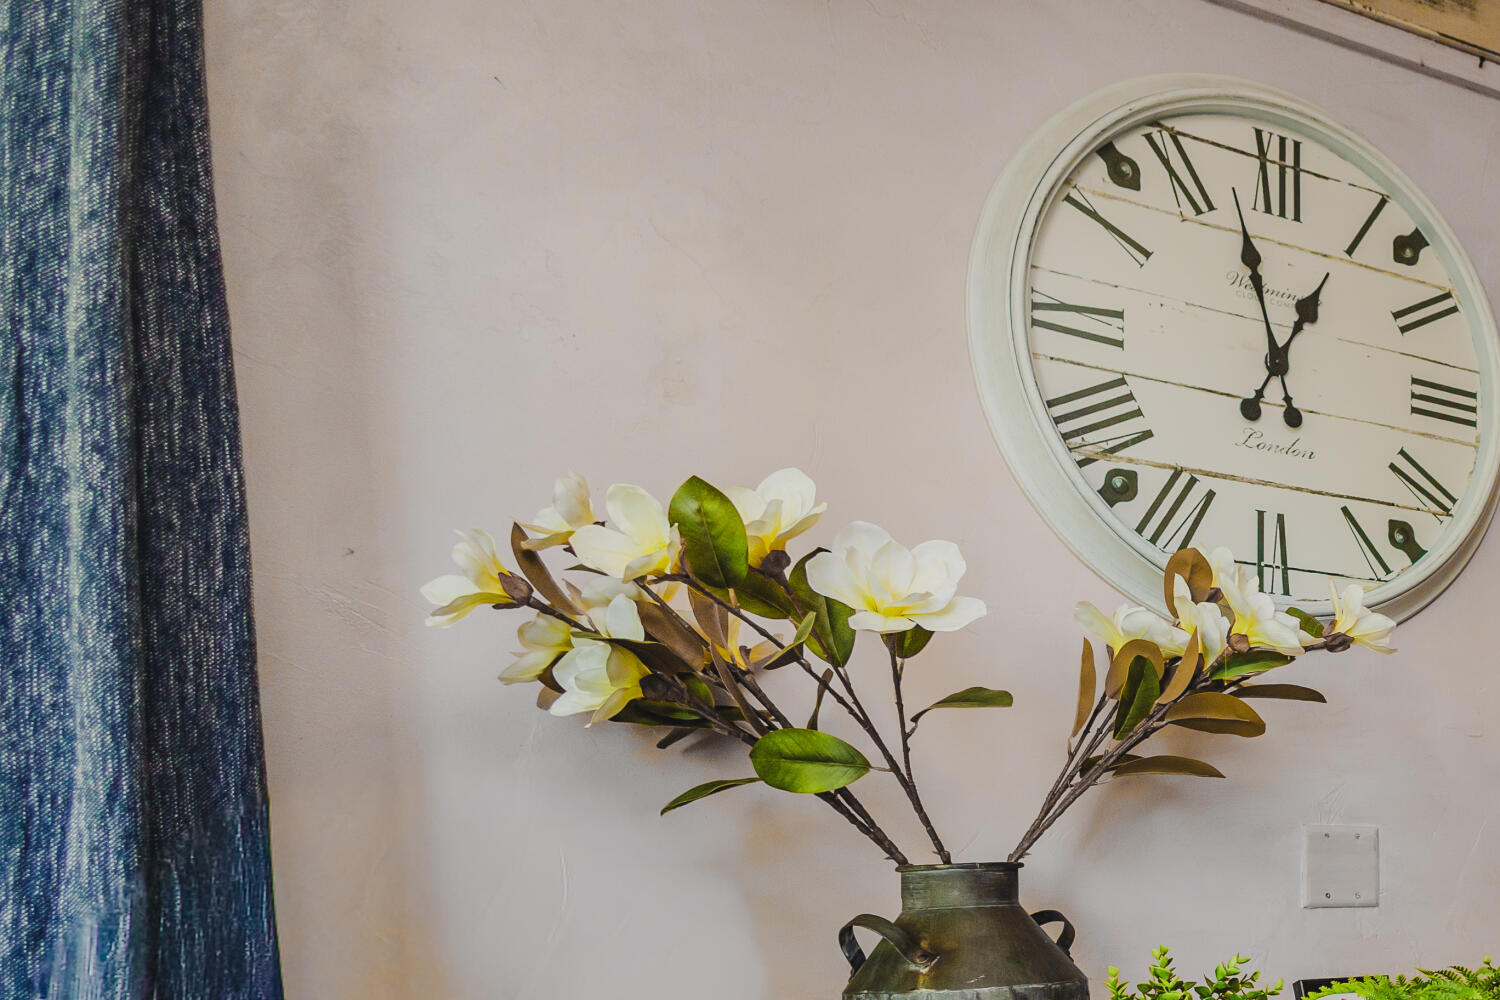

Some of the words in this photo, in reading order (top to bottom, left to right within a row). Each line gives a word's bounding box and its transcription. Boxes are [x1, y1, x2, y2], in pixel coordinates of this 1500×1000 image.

[1252, 127, 1303, 223] XII
[1410, 375, 1478, 428] III
[1234, 427, 1317, 460] London
